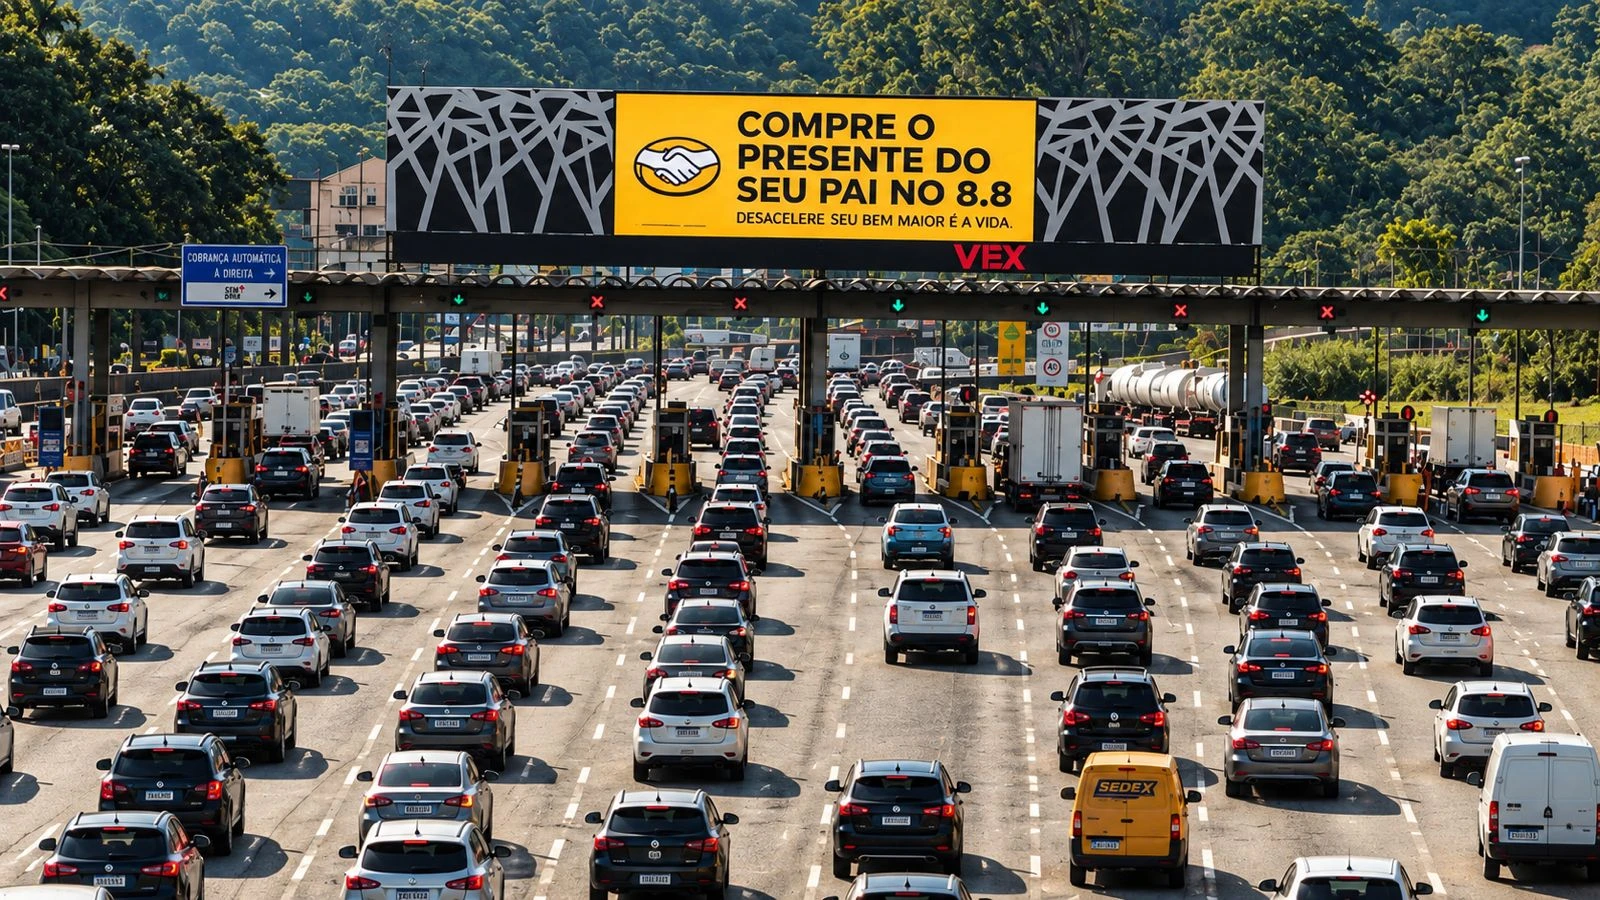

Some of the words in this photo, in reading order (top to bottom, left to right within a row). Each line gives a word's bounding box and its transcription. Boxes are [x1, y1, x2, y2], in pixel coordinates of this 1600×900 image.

[737, 110, 897, 140] COMPRE
[907, 113, 936, 141] O
[738, 143, 924, 173] PRESENTE
[936, 147, 991, 175] DO
[736, 176, 807, 204] SEU
[819, 178, 877, 205] PAI
[890, 179, 945, 206] NO
[956, 180, 1012, 208] 8.8
[736, 211, 825, 226] DESACELERE
[830, 212, 858, 226] SEU
[862, 213, 893, 227] BEM
[897, 214, 945, 228] MAIOR
[949, 212, 958, 228] É
[961, 216, 972, 228] A
[974, 216, 1013, 229] VIDA.
[187, 252, 229, 265] COBRANÇA
[231, 251, 282, 264] AUTOMÁTICA
[953, 243, 1026, 271] VEX
[223, 268, 254, 279] DIREITA
[1098, 781, 1154, 794] SEDEX
